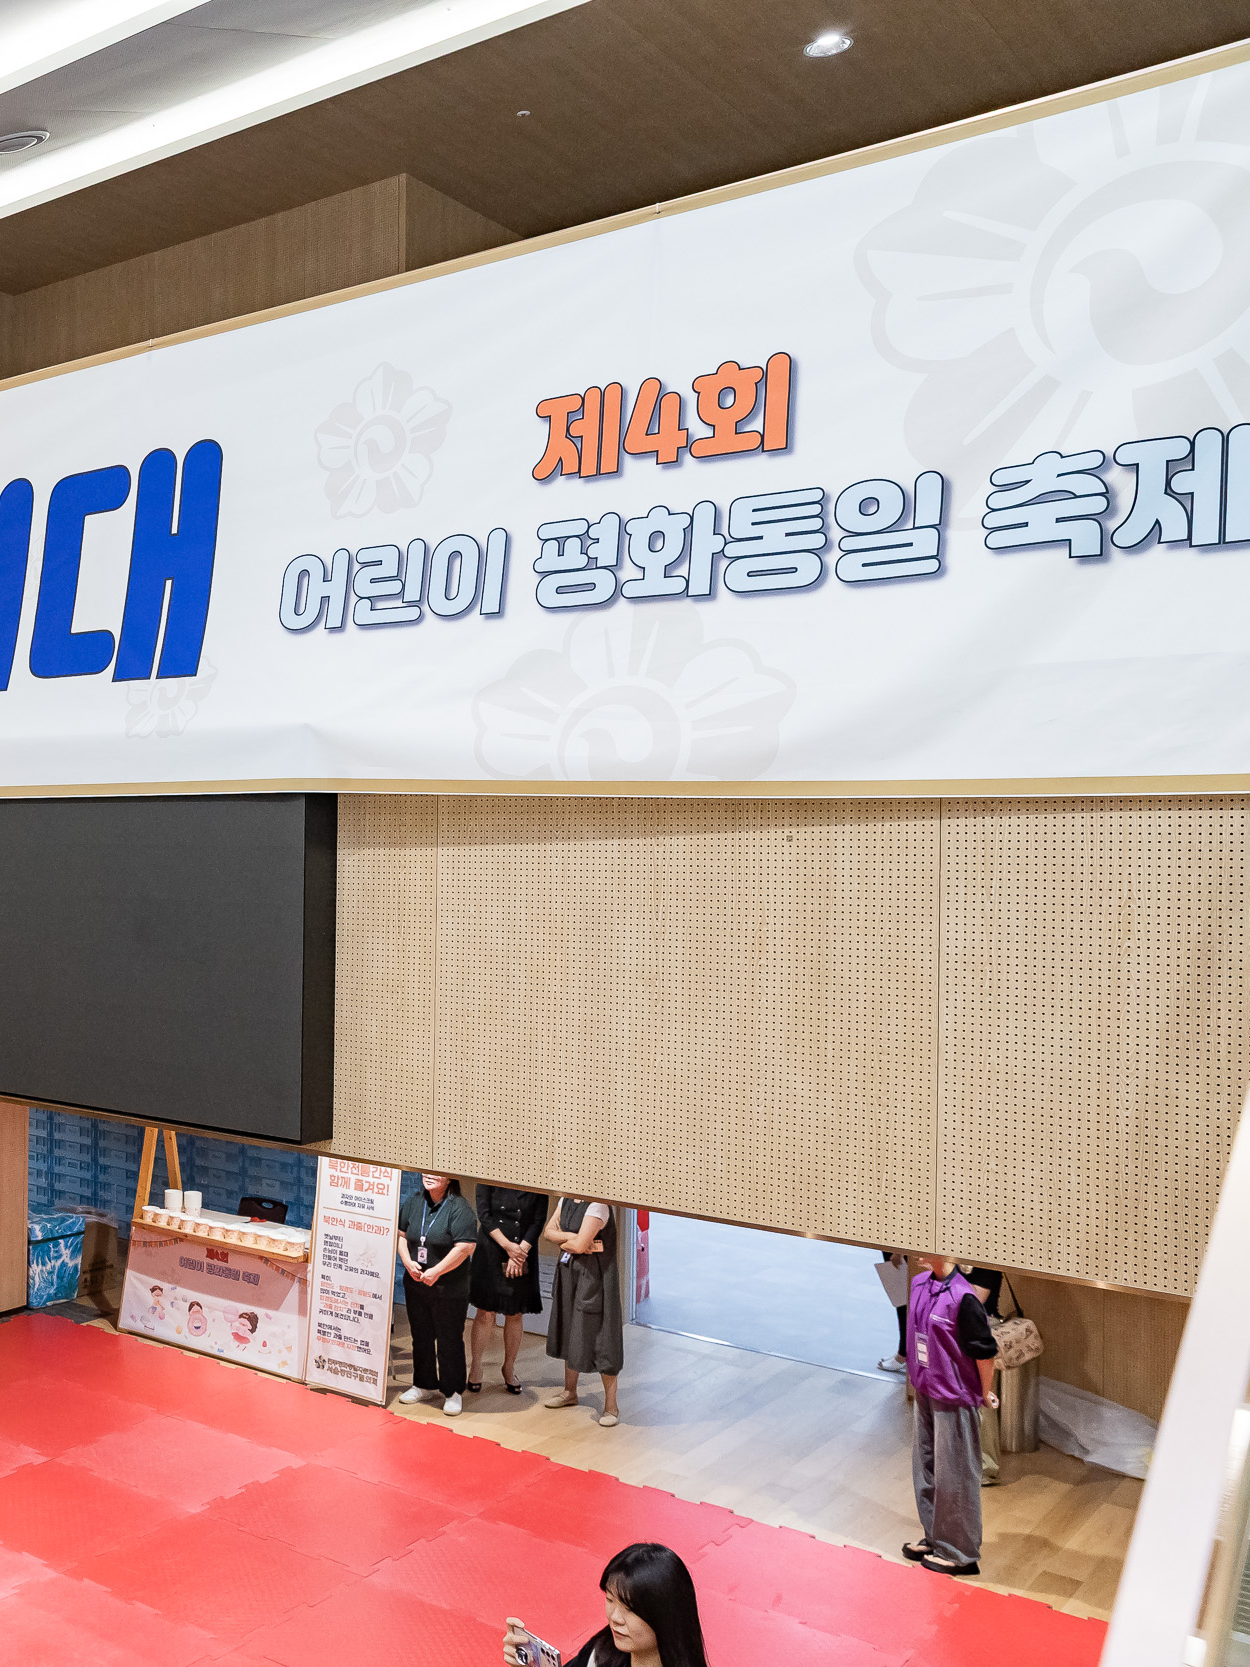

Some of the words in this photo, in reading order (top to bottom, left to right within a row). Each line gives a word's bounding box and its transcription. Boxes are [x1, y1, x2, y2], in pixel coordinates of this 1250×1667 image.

[532, 352, 793, 483] 제4회
[279, 527, 509, 632] 어린이
[532, 470, 946, 611] 평화통일
[981, 422, 1250, 559] 축제
[329, 1174, 351, 1190] 함께
[353, 1178, 390, 1196] 즐겨요!
[323, 1215, 346, 1228] 북한식
[178, 1255, 205, 1273] 어린이
[205, 1262, 241, 1282] 평화통일
